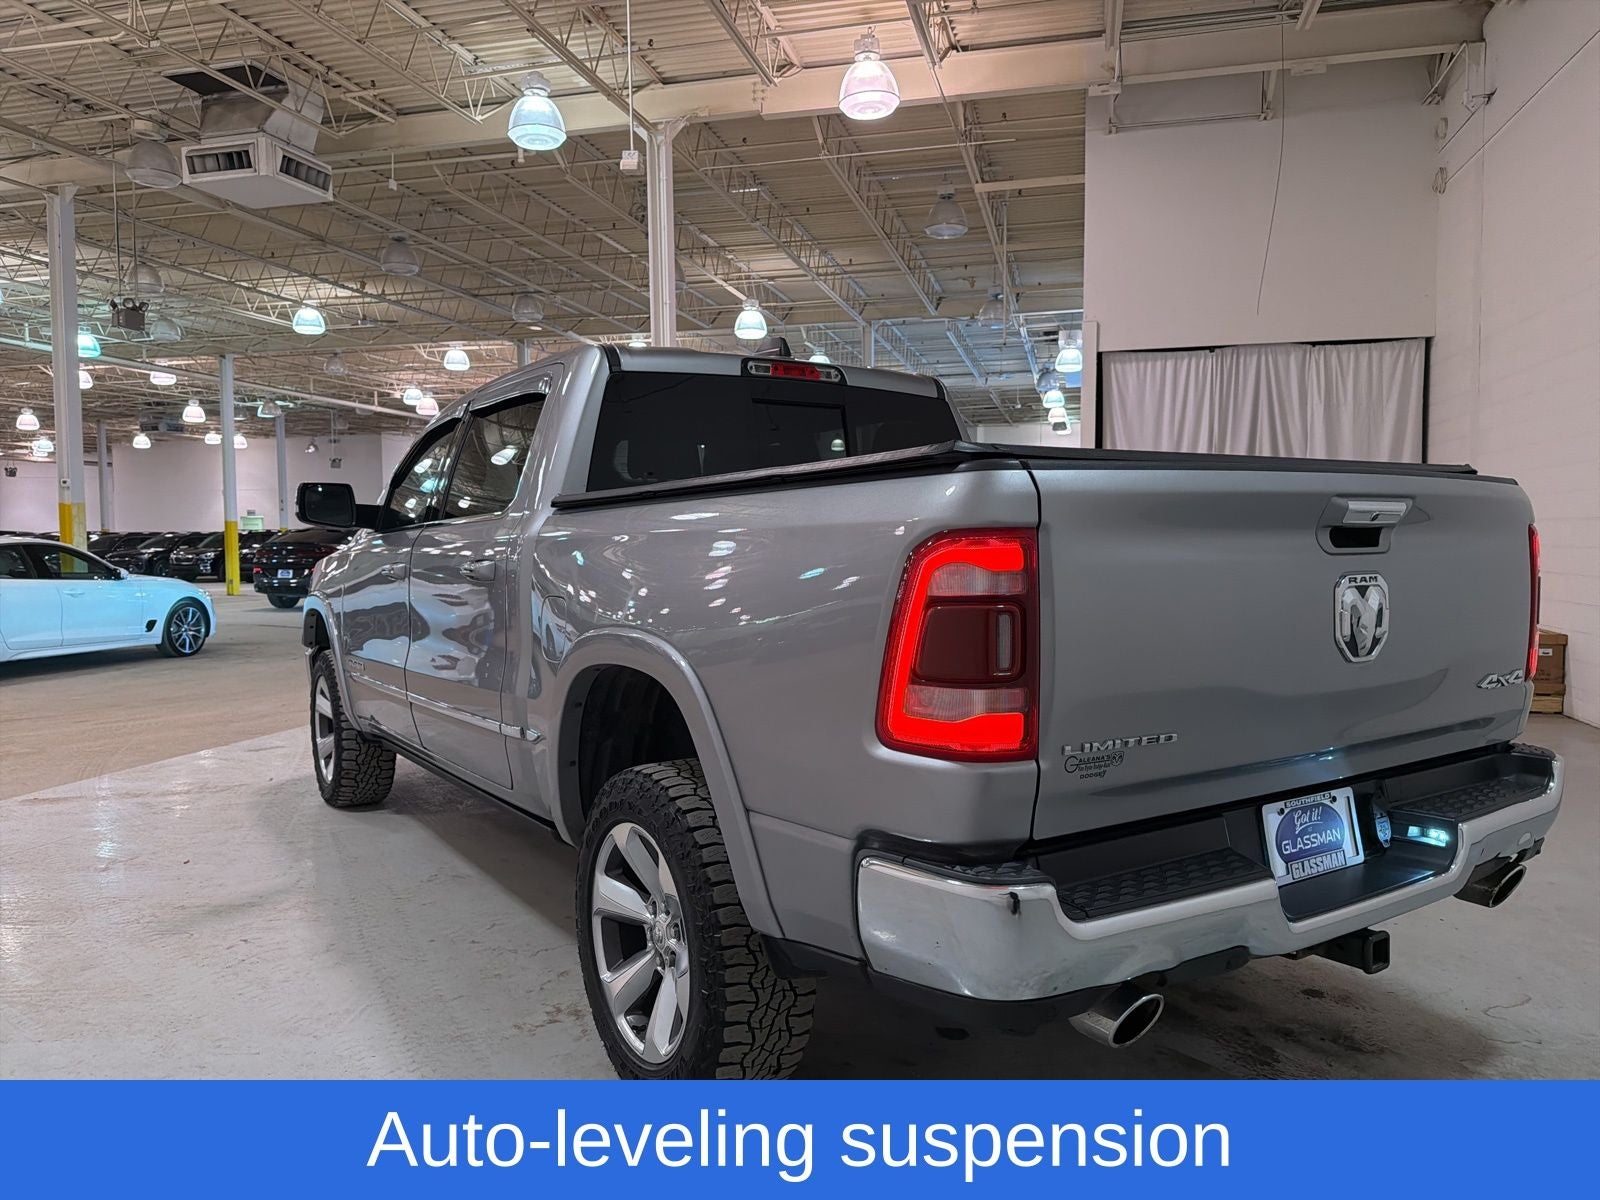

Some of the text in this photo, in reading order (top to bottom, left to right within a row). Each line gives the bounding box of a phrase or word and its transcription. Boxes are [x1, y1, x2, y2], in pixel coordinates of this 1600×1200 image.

[1348, 576, 1379, 584] RAM
[1062, 733, 1178, 755] LIMITED
[1285, 793, 1331, 808] SOUTHFIELD
[1311, 806, 1323, 821] it!
[1281, 829, 1341, 854] GLASSMAN
[1291, 851, 1345, 879] GLASSMAN
